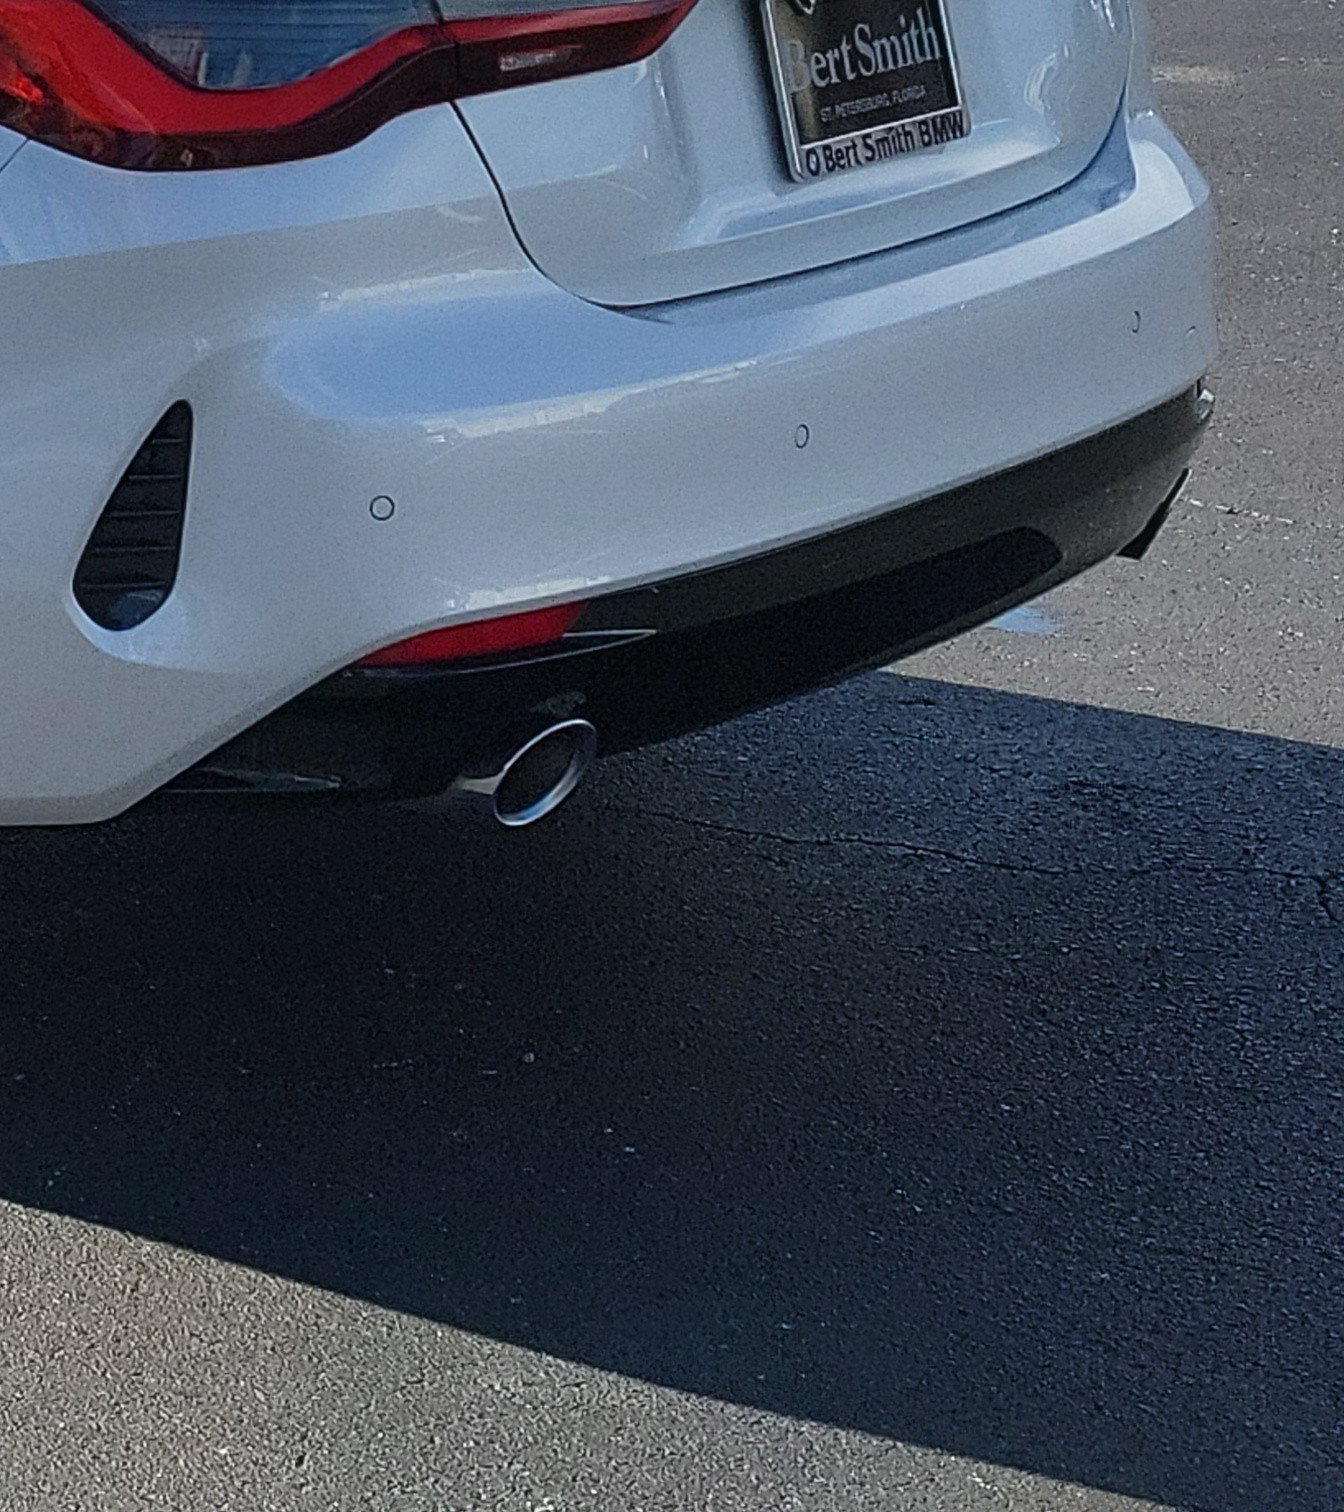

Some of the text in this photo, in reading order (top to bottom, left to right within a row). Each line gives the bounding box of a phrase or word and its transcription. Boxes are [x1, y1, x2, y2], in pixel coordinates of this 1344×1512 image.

[784, 7, 942, 93] Bert Smith
[823, 110, 963, 172] Bert Smith BMW
